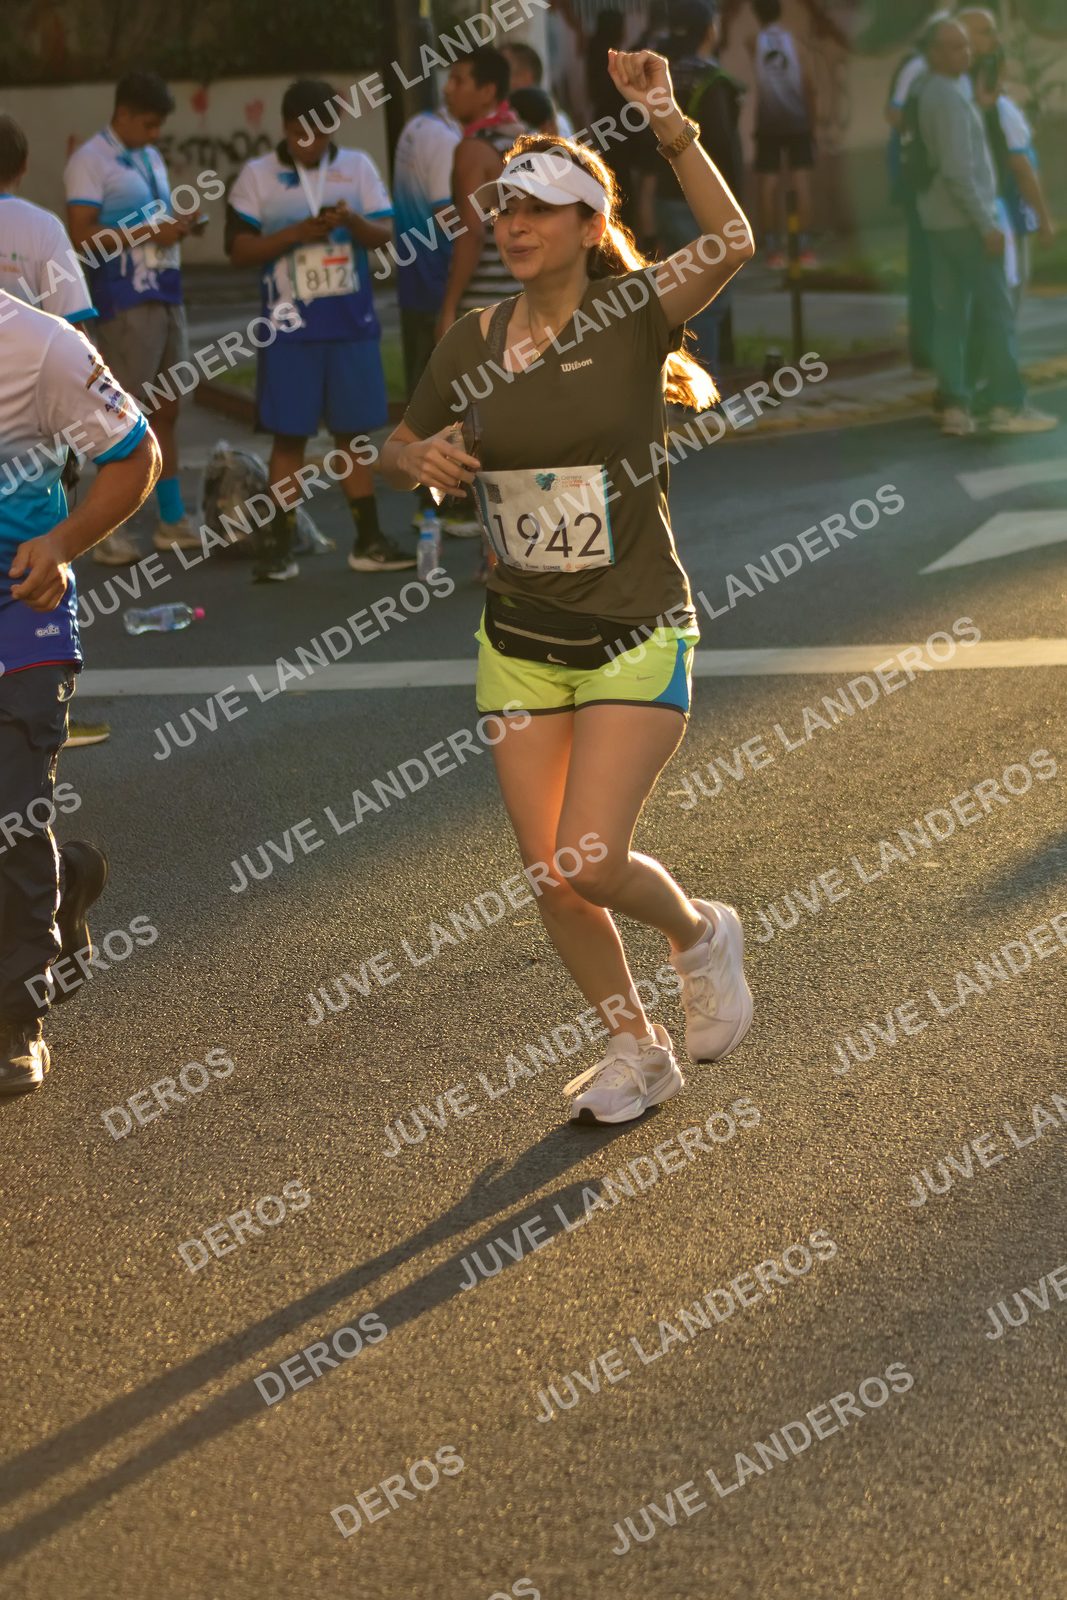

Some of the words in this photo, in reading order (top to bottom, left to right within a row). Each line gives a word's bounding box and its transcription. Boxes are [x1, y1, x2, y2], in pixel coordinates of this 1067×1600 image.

[306, 267, 348, 291] 812
[560, 358, 593, 373] Wilson
[493, 512, 605, 558] 1942
